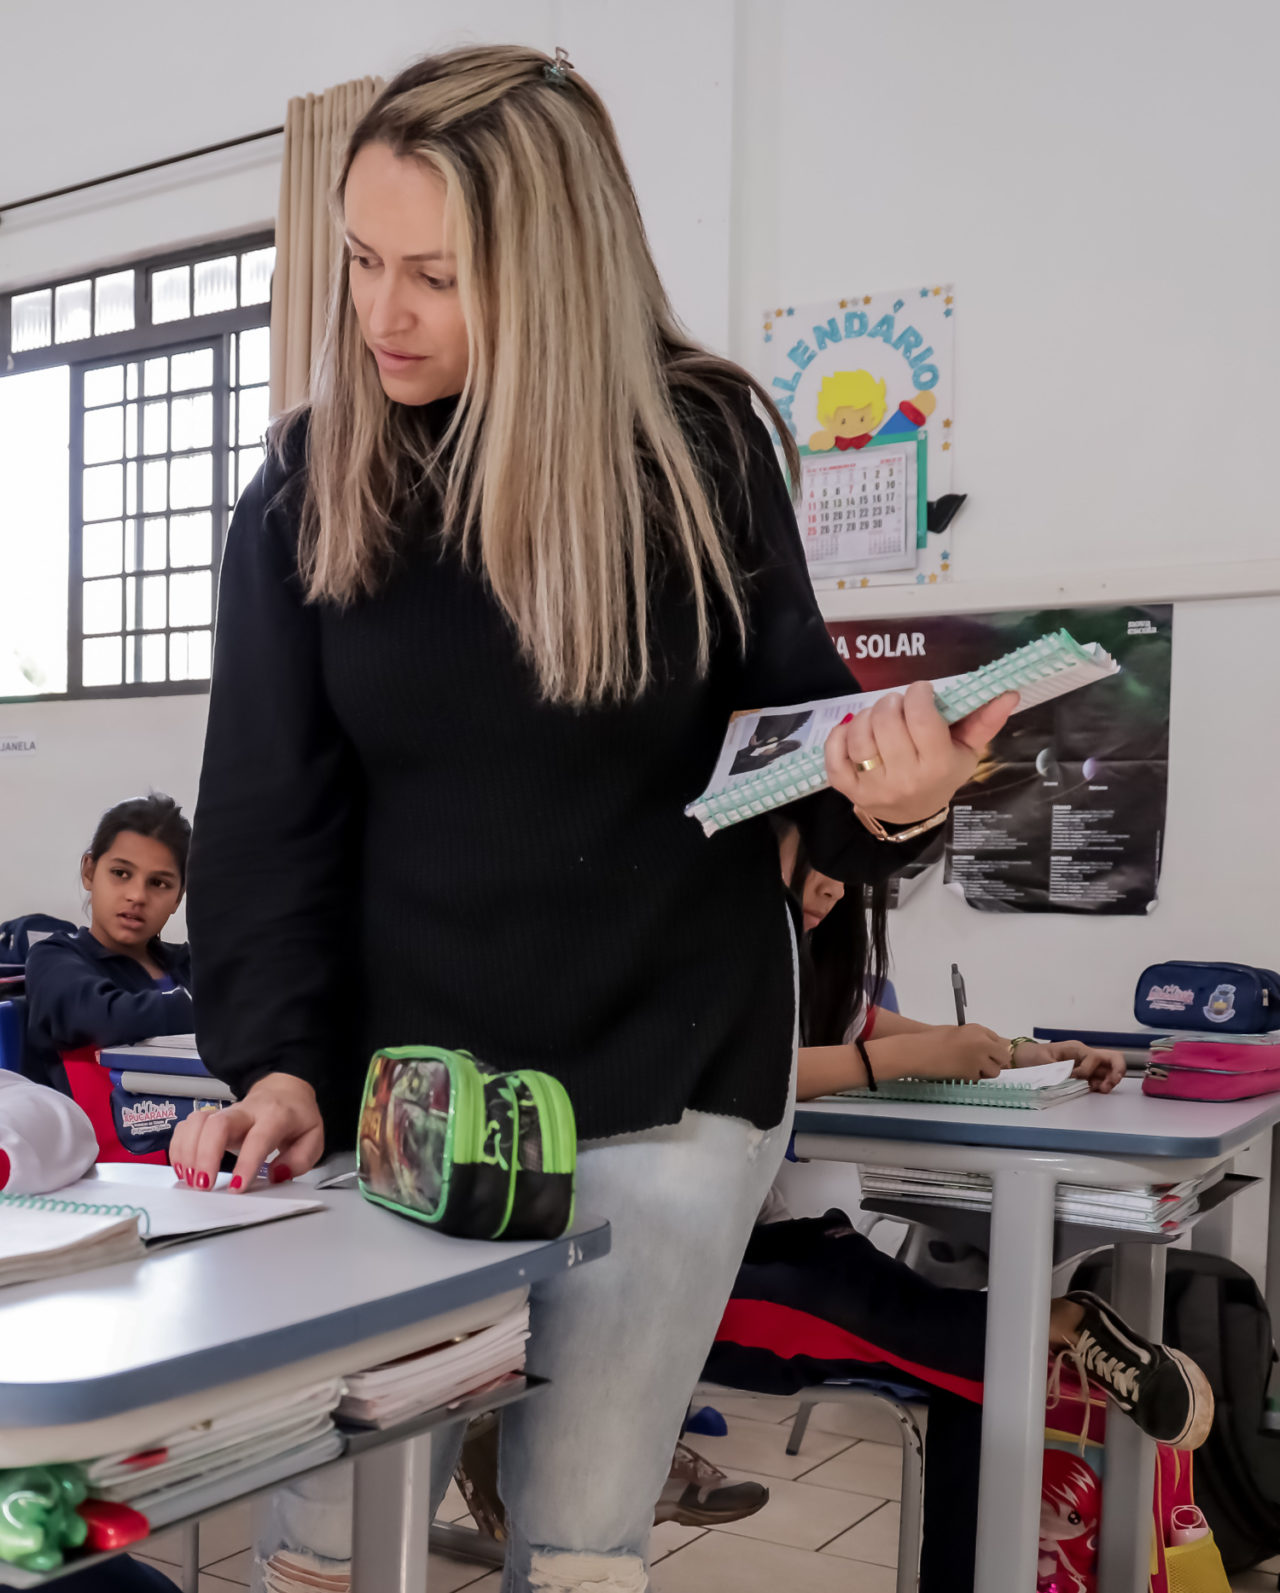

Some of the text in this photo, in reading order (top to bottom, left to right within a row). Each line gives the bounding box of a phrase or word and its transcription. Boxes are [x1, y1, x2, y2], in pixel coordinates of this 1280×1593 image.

[820, 500, 829, 509] 12
[833, 499, 842, 508] 13
[846, 497, 855, 506] 14
[859, 495, 868, 505] 15
[886, 492, 895, 501] 17
[833, 511, 843, 521] 20
[846, 510, 856, 519] 21
[859, 508, 869, 518] 22
[872, 506, 882, 516] 23
[885, 505, 895, 515] 24
[820, 525, 830, 535] 26
[833, 524, 843, 533] 27
[846, 522, 856, 532] 28
[859, 520, 869, 530] 29
[872, 519, 882, 529] 30
[832, 632, 927, 659] A SOLAR
[0, 741, 36, 752] JANELA
